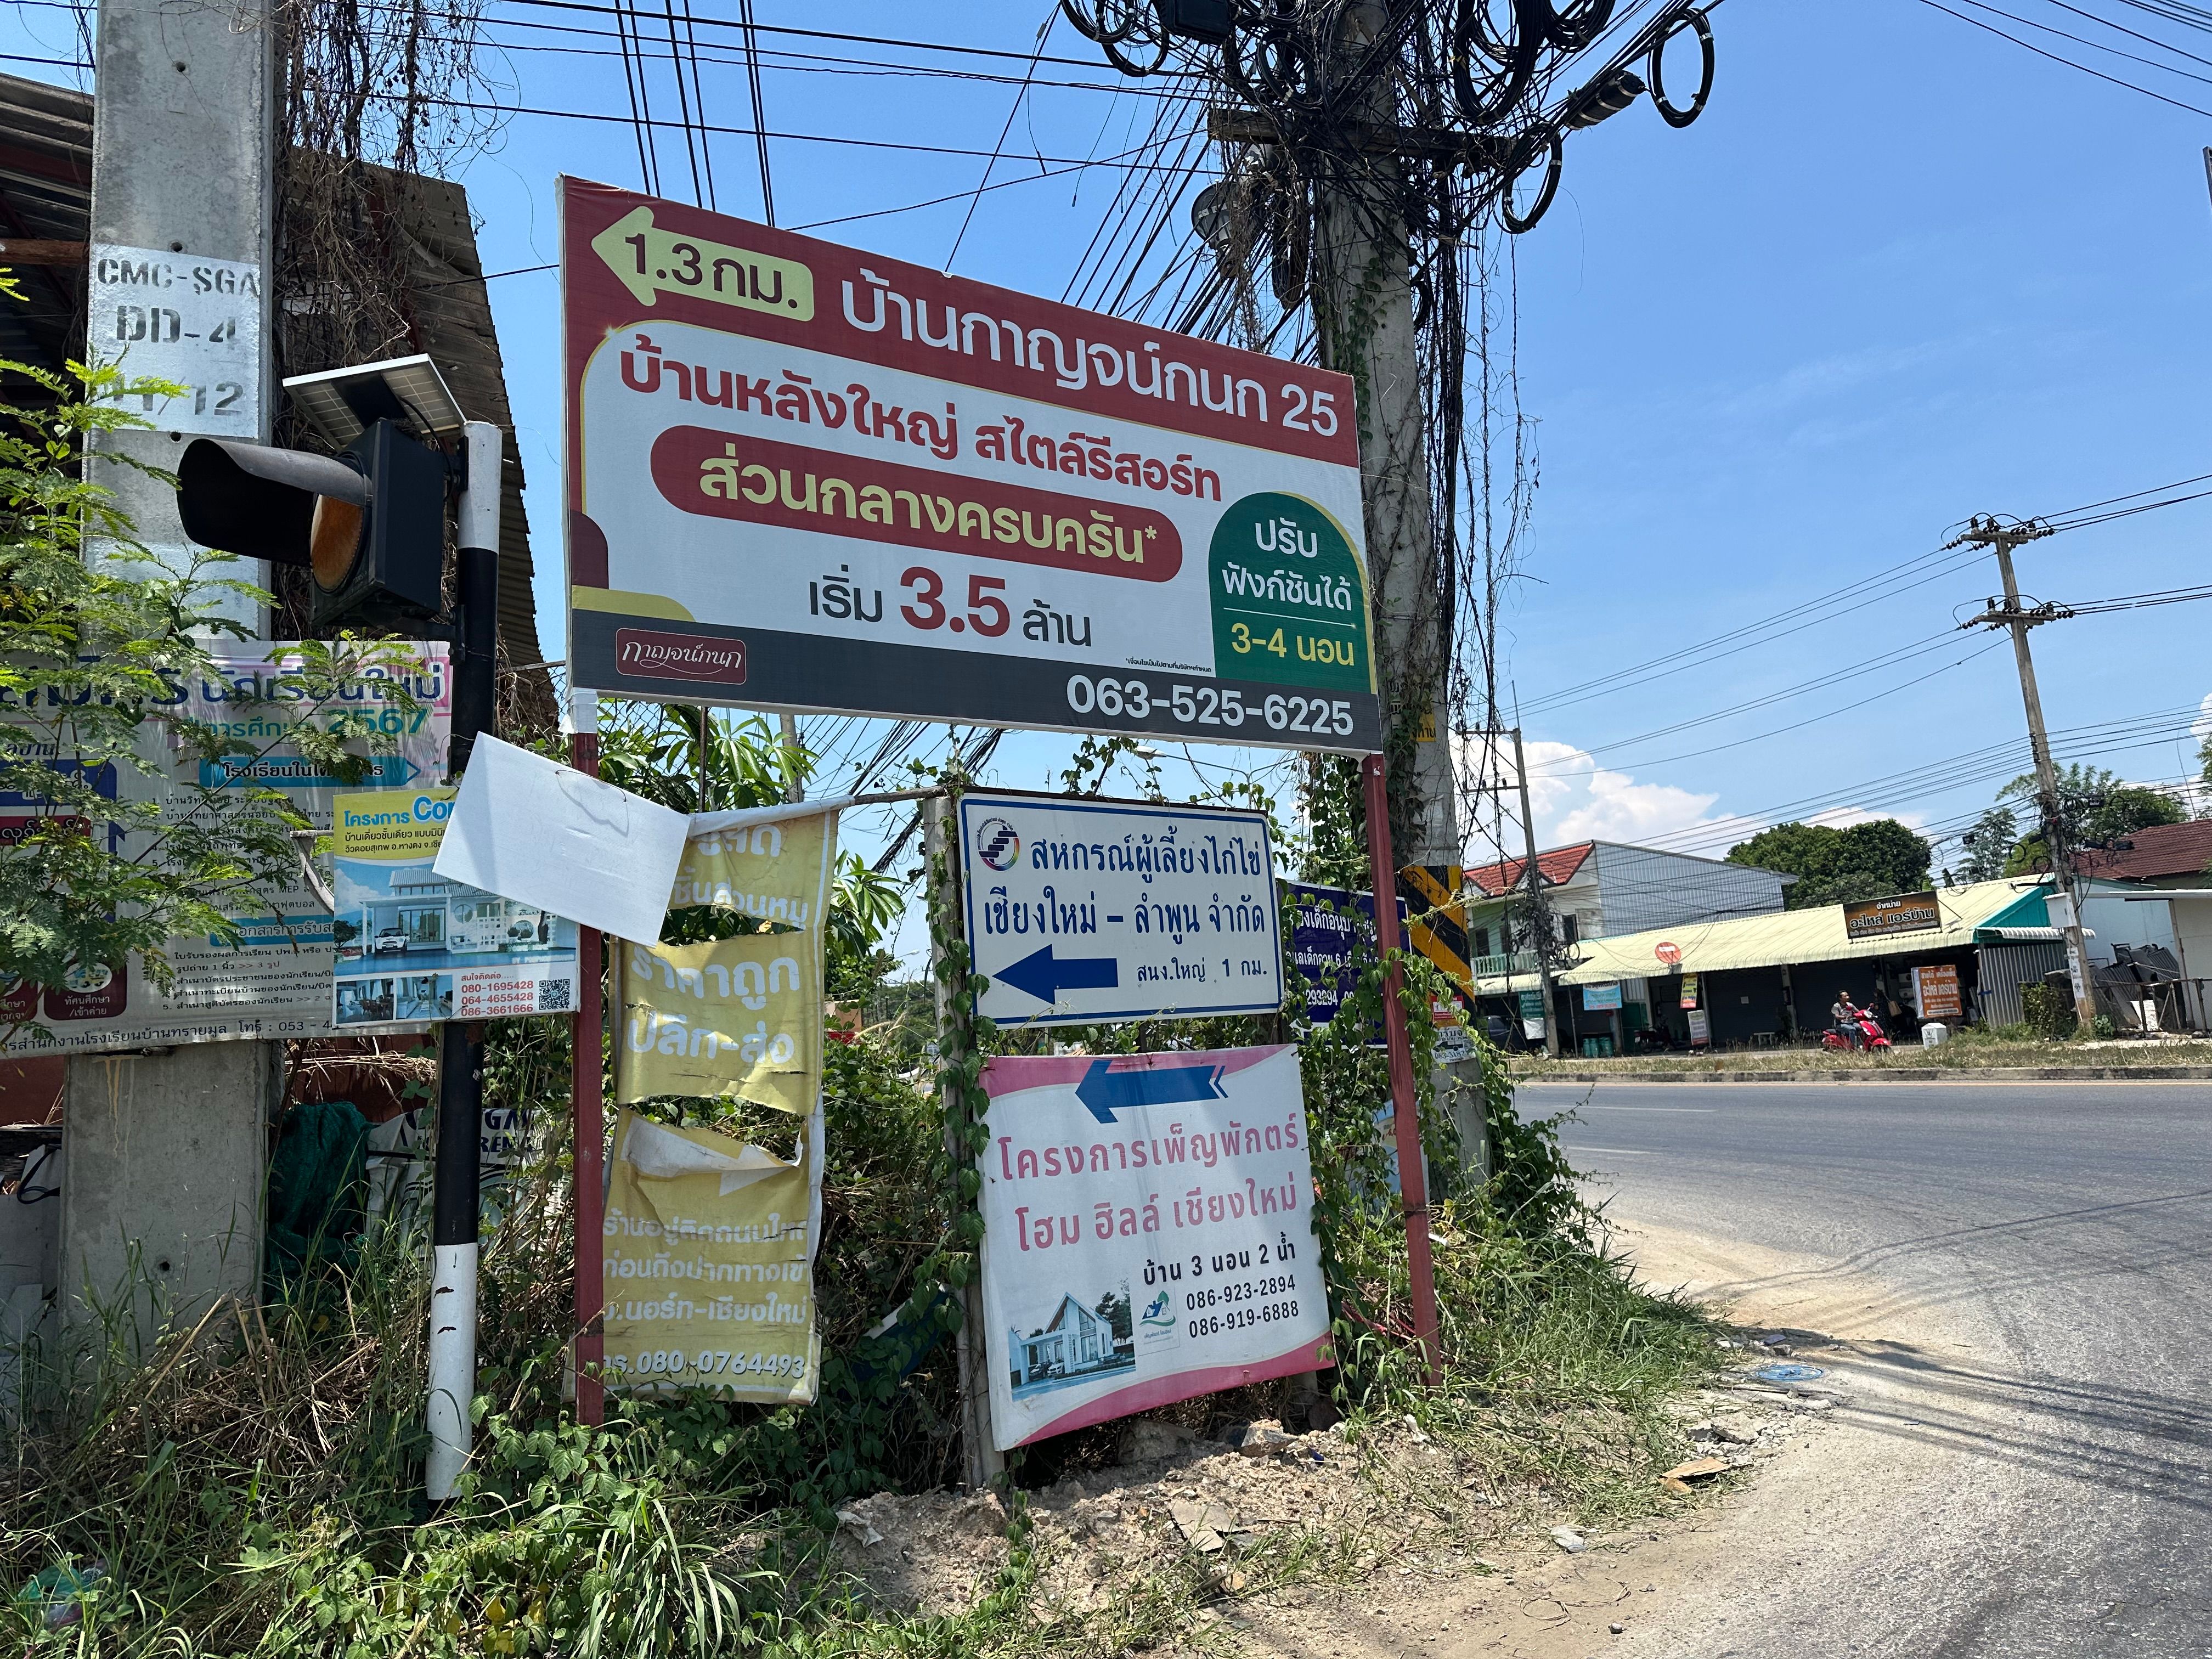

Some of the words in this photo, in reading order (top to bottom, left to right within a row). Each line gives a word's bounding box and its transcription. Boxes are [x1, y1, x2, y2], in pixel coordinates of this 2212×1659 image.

[97, 258, 259, 296] CMC-SGA
[116, 305, 236, 348] DD-4
[842, 267, 1268, 422] บ้านกาญจน์กนก
[1280, 383, 1339, 437] 25
[620, 334, 958, 460] บ้านหลังใหญ่
[975, 414, 1222, 502] สไตล์รีสอร์ท
[1255, 517, 1318, 558] ปรับ
[809, 564, 883, 623] เริ่ม
[899, 566, 1011, 638] 3.5
[1023, 599, 1091, 647] ล้าน
[1221, 561, 1352, 611] ฟังก์ชันได้
[622, 641, 742, 675] กาญจน์กนก
[1231, 623, 1287, 658] 3-4
[1297, 635, 1355, 667] นอน
[1066, 674, 1354, 736] 063-525-6225
[344, 810, 410, 827] โครงการ
[345, 827, 413, 842] บ้านเดี่ยวชั้นเดียว
[345, 843, 390, 854] วิวดอยสุเทพ
[391, 841, 422, 850] อ.หางดง
[1030, 825, 1261, 884] สหกรณ์ผู้เลี้ยงไก่ไข่
[984, 885, 1097, 934] เชียงใหม่
[1133, 892, 1200, 945] ลำพูน
[1207, 893, 1265, 933] จำกัด
[1887, 907, 1936, 924] แอร์บ้าน
[461, 980, 534, 994] 080-1695428
[631, 945, 800, 1011] ราคาถูก
[1137, 957, 1206, 983] สนง.ใหญ่
[1222, 958, 1231, 978] 1
[1241, 959, 1268, 976] กม.
[461, 992, 534, 1005] 064-4655428
[461, 1003, 534, 1017] 086-3661666
[278, 1022, 304, 1031] 053
[628, 1011, 795, 1064] ปลีก-ส่ง
[997, 1113, 1300, 1181] โครงการเพ็ญพักตร์
[1014, 1207, 1080, 1252] โฮม
[1093, 1193, 1160, 1240] ฮิลล์
[1173, 1171, 1297, 1229] เชียงใหม่
[1143, 1259, 1182, 1286] บ้าน
[1191, 1255, 1203, 1277] 3
[1212, 1250, 1250, 1273] นอน
[1259, 1244, 1269, 1265] 2
[1277, 1232, 1296, 1262] น้ำ
[1186, 1274, 1296, 1311] 086-923-2894
[1189, 1300, 1300, 1339] 086-919-6888
